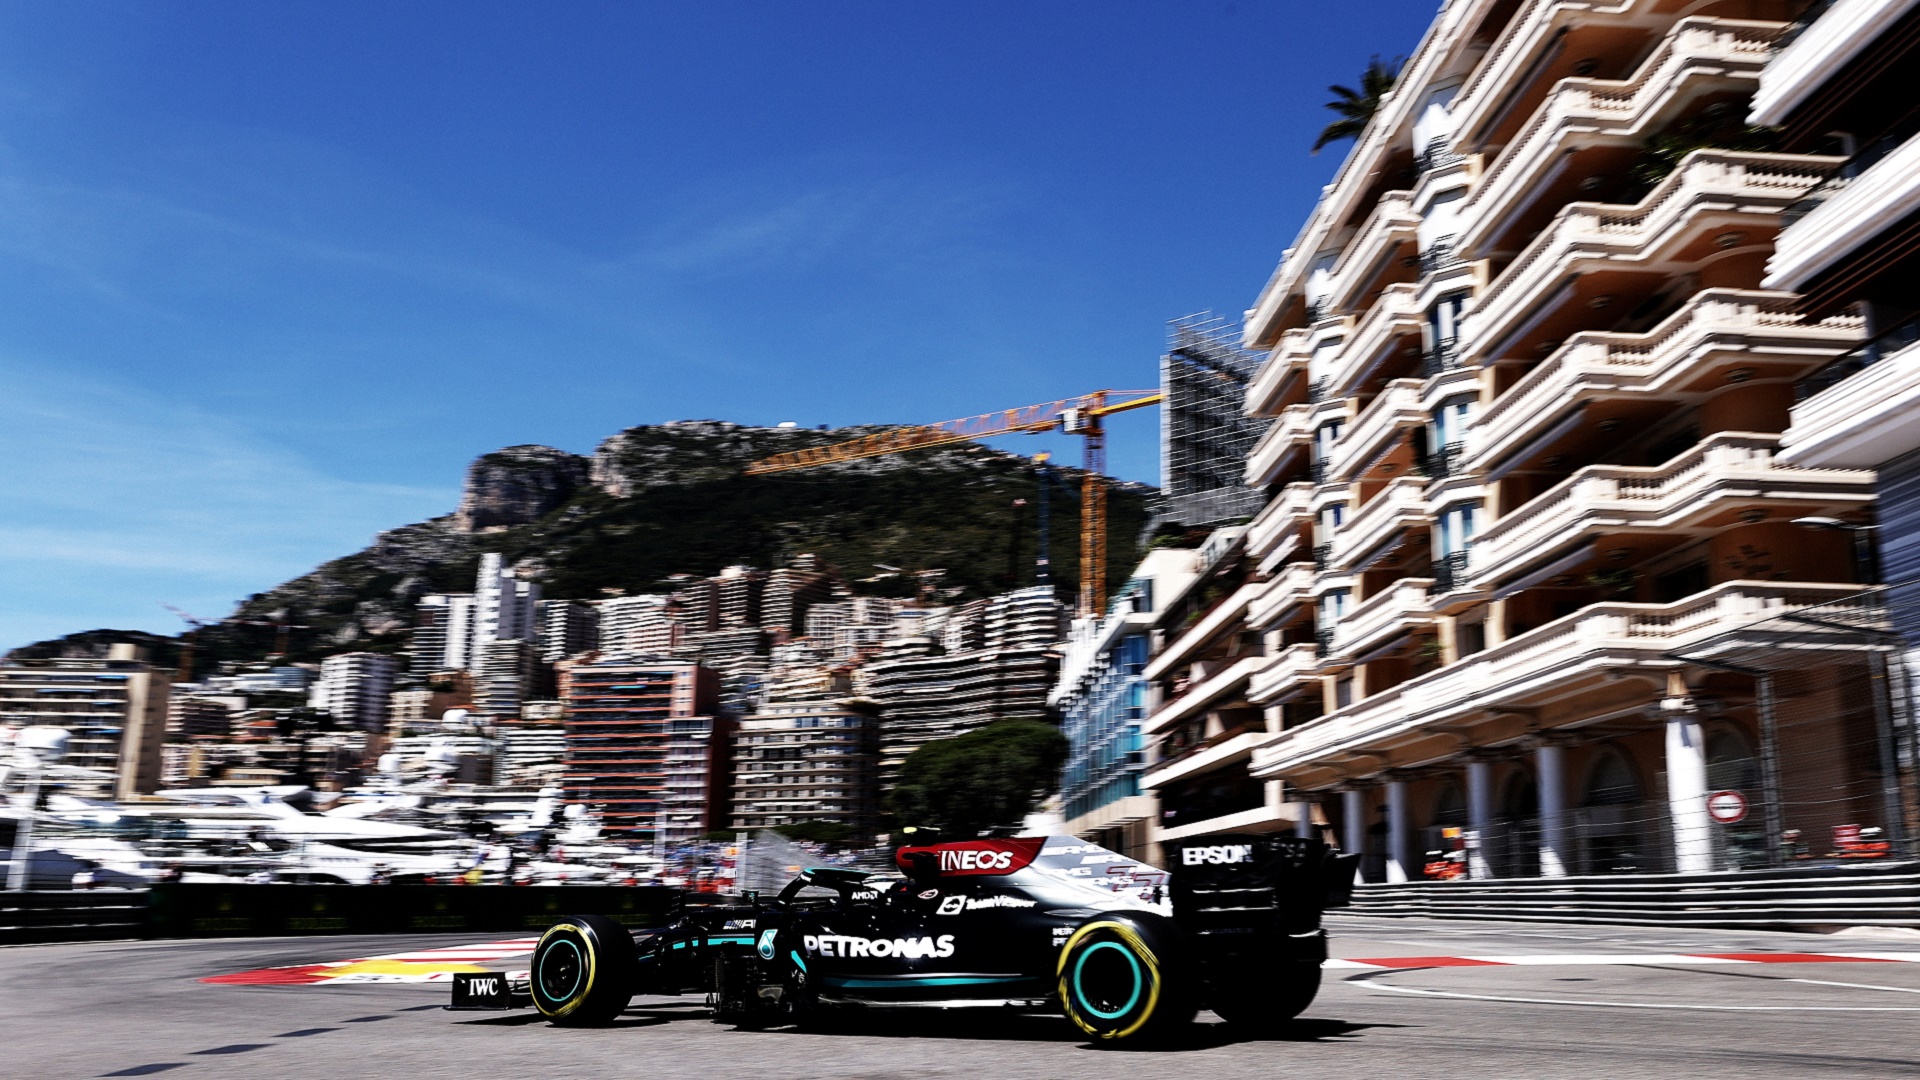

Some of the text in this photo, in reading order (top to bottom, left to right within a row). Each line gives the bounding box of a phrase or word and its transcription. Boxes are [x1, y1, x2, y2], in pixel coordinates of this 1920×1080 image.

[941, 850, 1014, 870] INEOS
[1182, 845, 1254, 865] EPSON
[852, 891, 872, 900] AMD
[804, 934, 956, 958] PETRONAS
[468, 978, 499, 996] IWC
